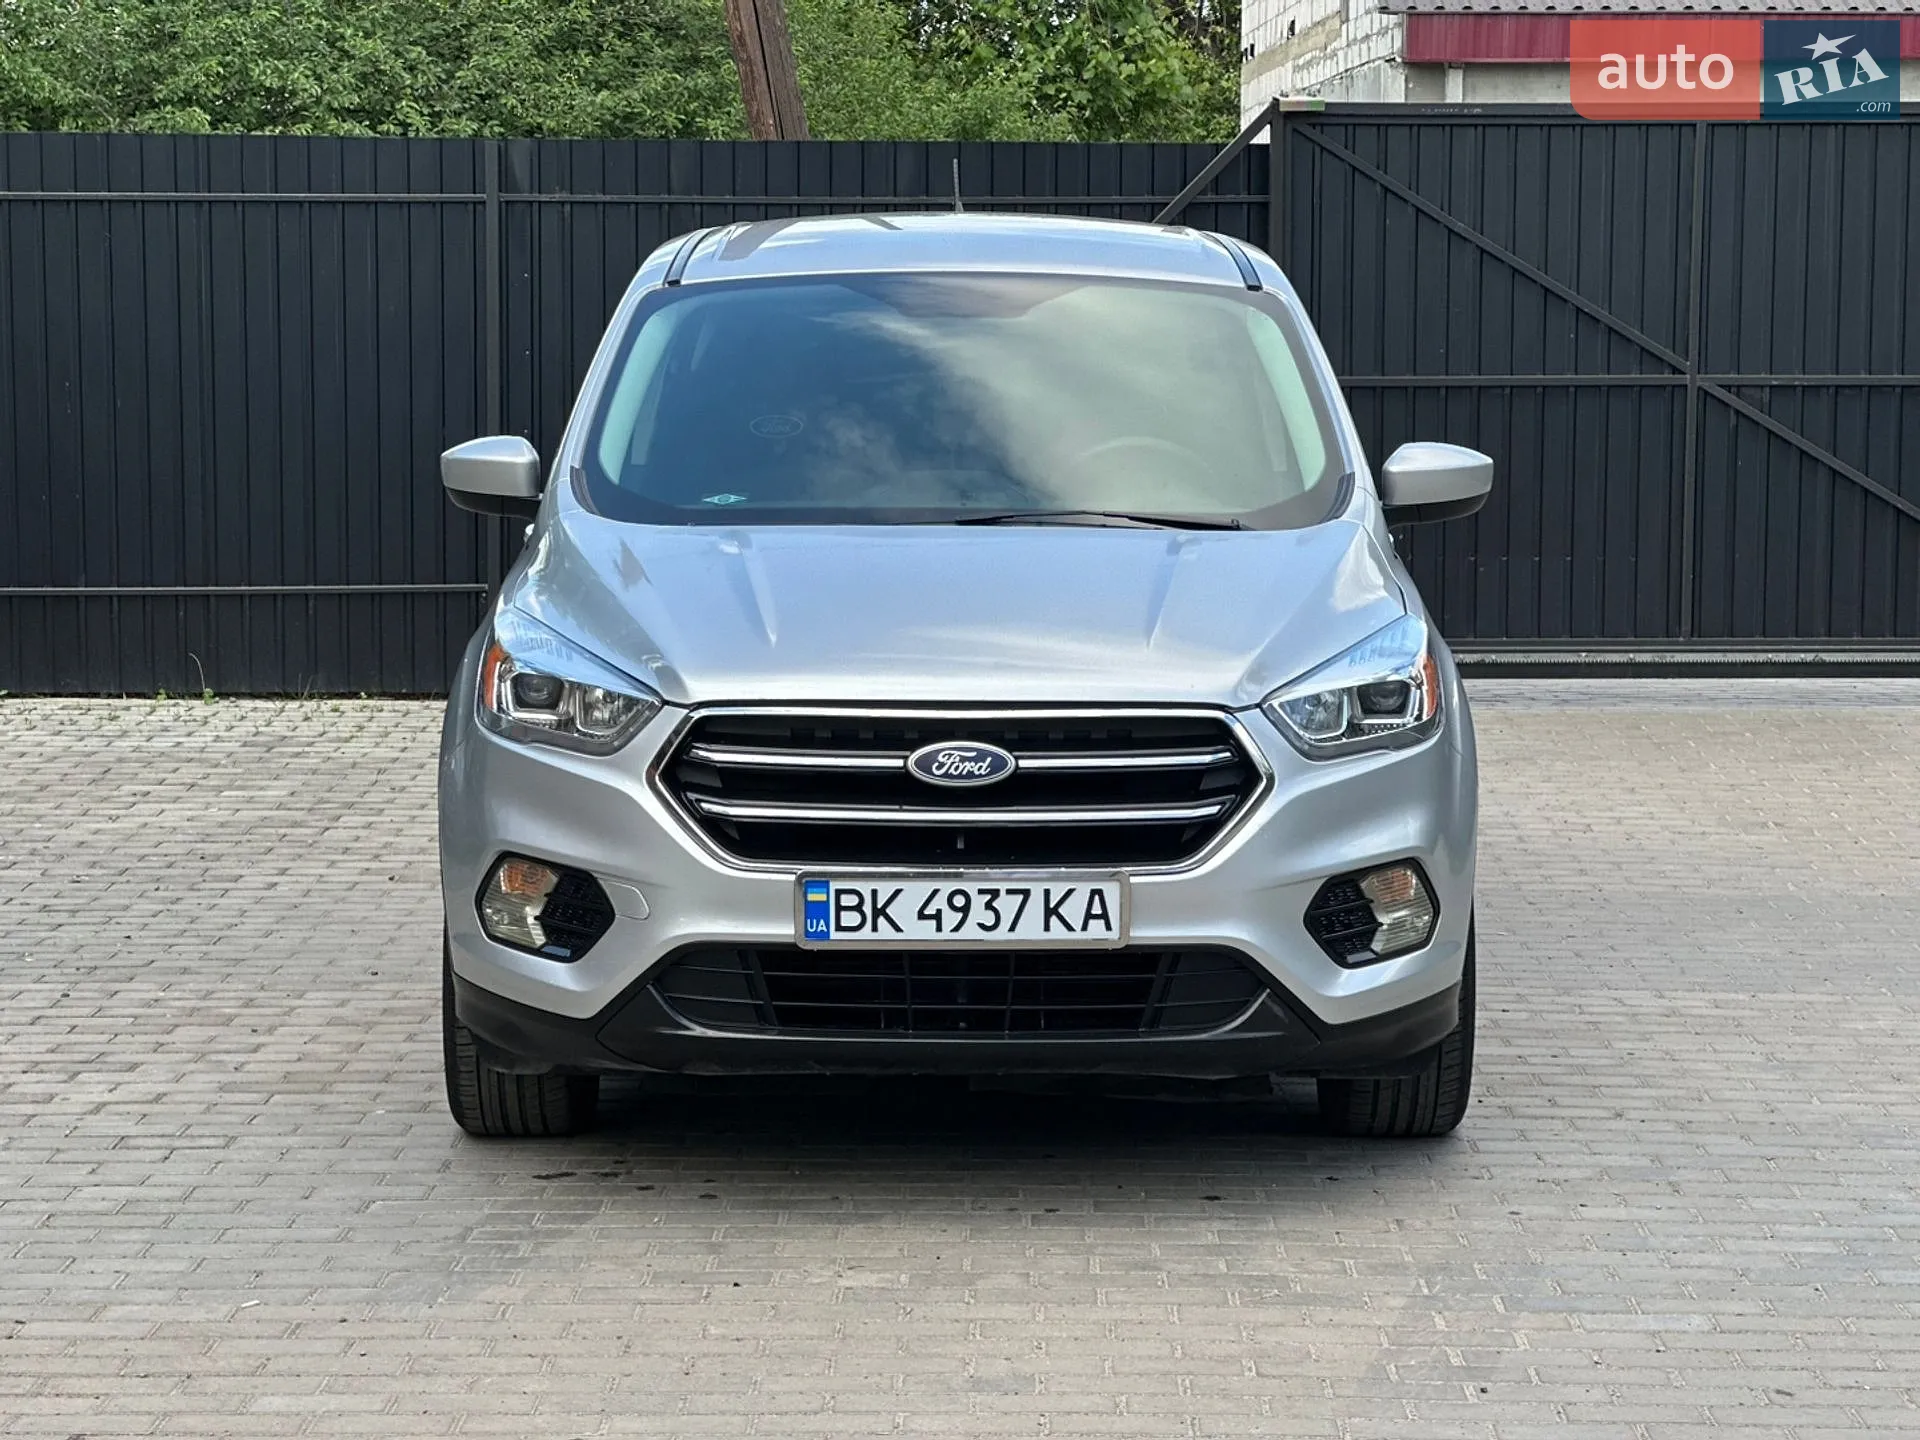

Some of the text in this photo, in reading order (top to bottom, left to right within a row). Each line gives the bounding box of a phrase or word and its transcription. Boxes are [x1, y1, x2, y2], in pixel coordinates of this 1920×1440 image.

[931, 750, 992, 776] Ford
[833, 887, 1113, 933] BK 4937 KA
[806, 919, 828, 933] UA
